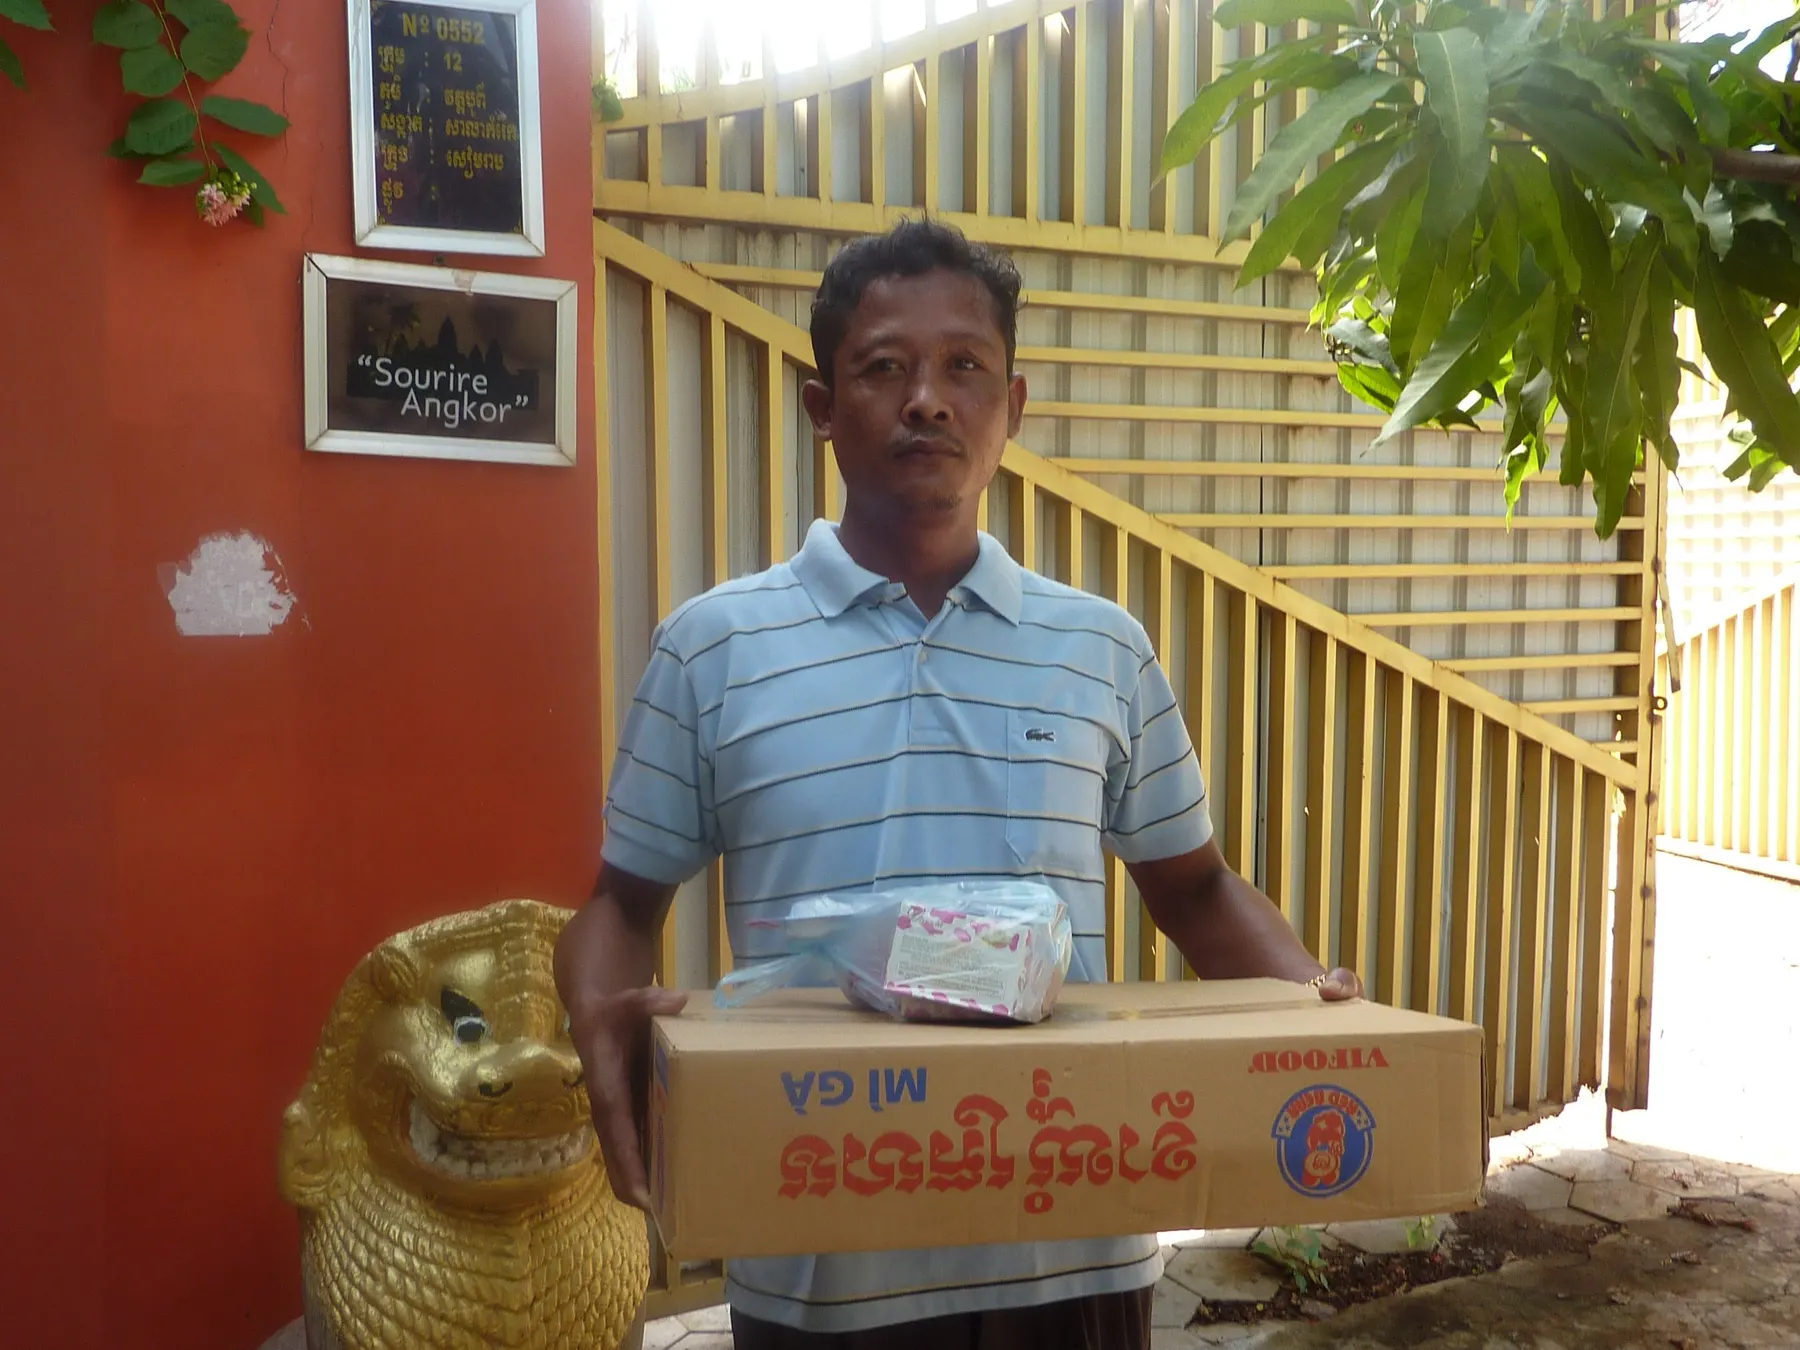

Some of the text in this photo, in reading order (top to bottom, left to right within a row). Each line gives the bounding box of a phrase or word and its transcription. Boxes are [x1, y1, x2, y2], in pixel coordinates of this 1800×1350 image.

[436, 16, 485, 45] 0552
[443, 52, 463, 72] 12
[447, 145, 504, 179] សៀមរាប
[1251, 1046, 1390, 1073] VIFOOD
[780, 1066, 927, 1116] MÌ GÀ
[1328, 1090, 1359, 1116] RED
